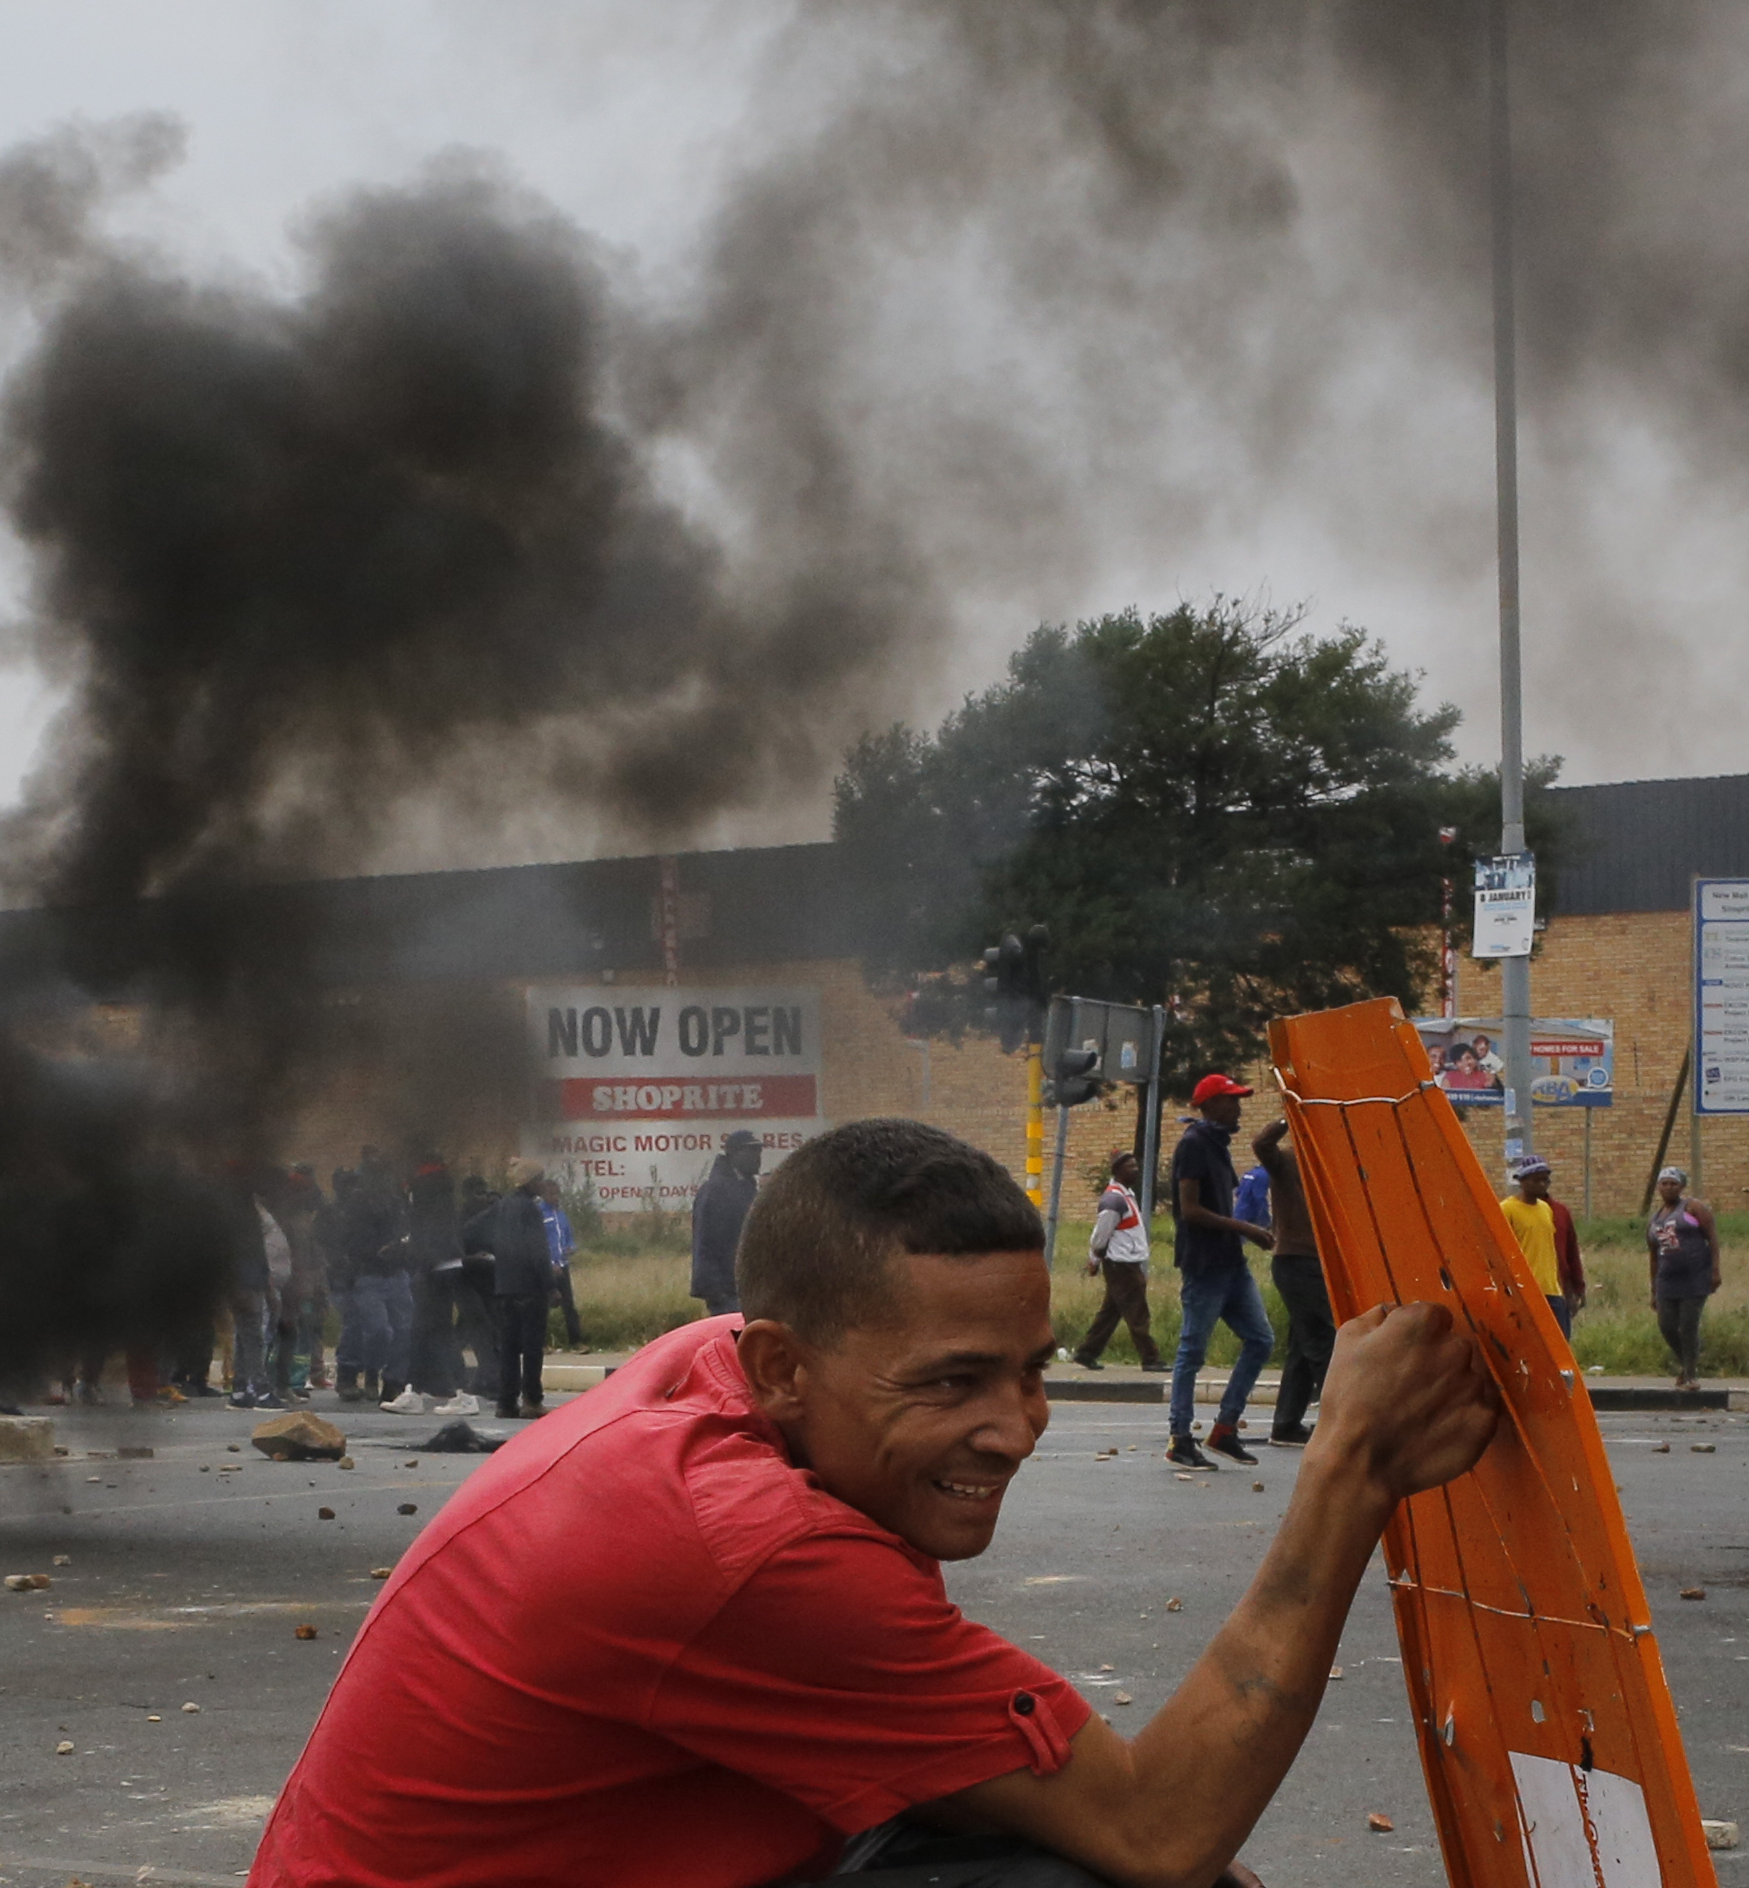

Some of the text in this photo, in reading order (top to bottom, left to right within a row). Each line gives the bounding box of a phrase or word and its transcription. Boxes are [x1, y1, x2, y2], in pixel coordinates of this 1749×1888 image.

[1488, 892, 1525, 902] JANUARY
[550, 1005, 803, 1058] NOW OPEN
[1533, 1043, 1600, 1054] HOMES FOR SALE
[591, 1083, 765, 1113] SHOPRITE
[552, 1132, 802, 1153] MAGIC MOTOR SRES
[580, 1160, 626, 1176] TEL:
[600, 1186, 643, 1199] OPEN
[659, 1185, 699, 1198] DAYS
